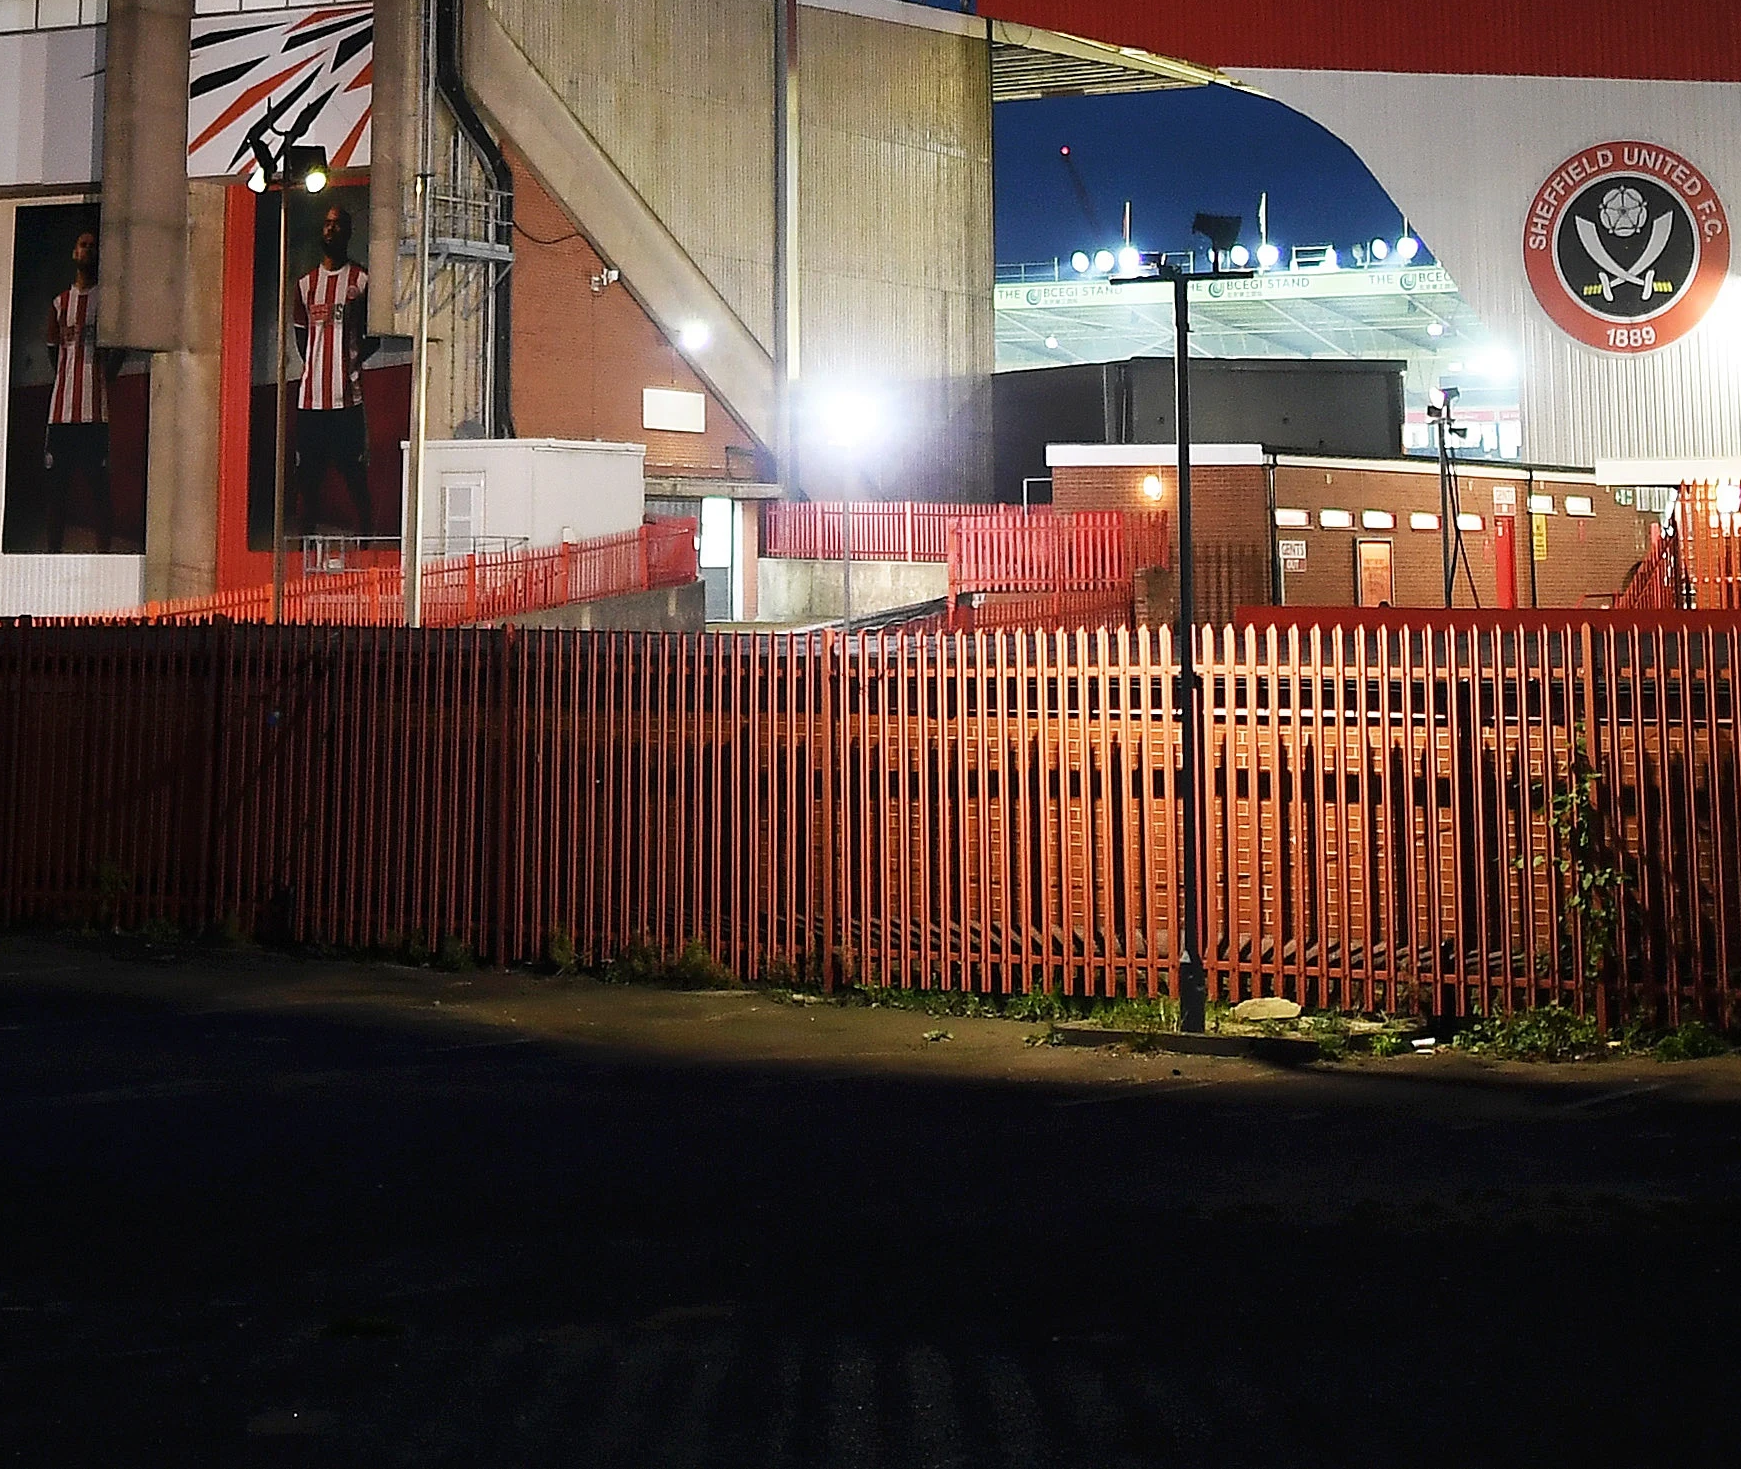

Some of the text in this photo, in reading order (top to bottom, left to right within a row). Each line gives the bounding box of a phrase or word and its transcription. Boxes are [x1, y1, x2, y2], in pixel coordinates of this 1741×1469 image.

[1529, 147, 1724, 251] SHEFFIELD UNITED F.C.
[1267, 277, 1310, 289] STAND
[1369, 271, 1452, 284] THE BCEG
[998, 286, 1122, 300] THE BCEGI STAND
[1606, 325, 1656, 348] 1889
